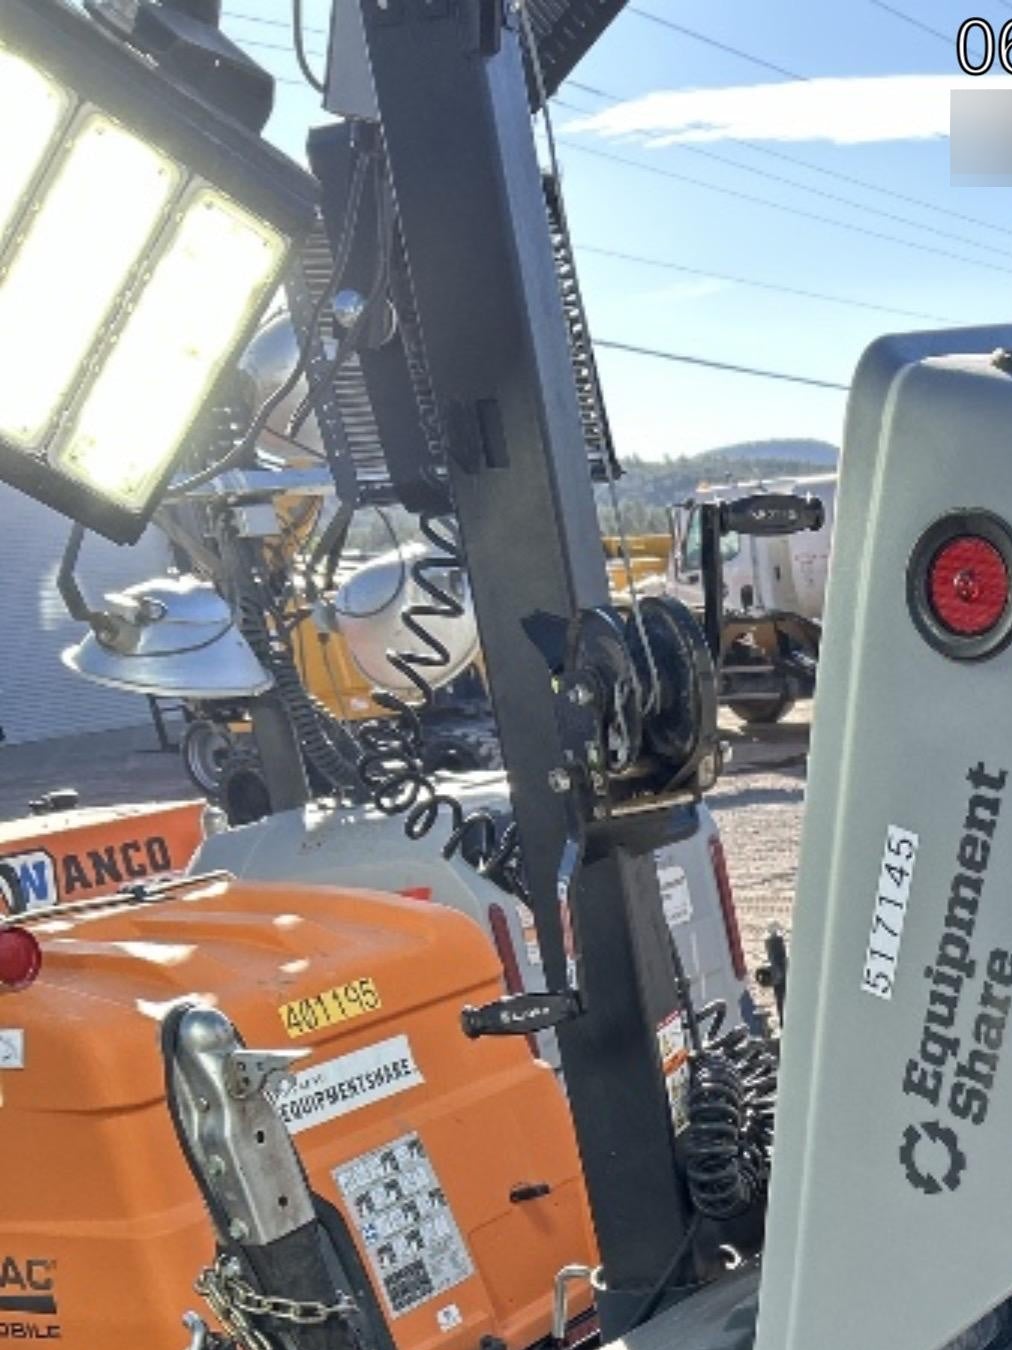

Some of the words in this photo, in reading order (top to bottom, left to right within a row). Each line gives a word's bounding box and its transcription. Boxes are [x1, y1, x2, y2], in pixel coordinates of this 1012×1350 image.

[863, 835, 916, 996] 517145
[903, 760, 1008, 1107] Equipment
[286, 978, 379, 1032] 401195
